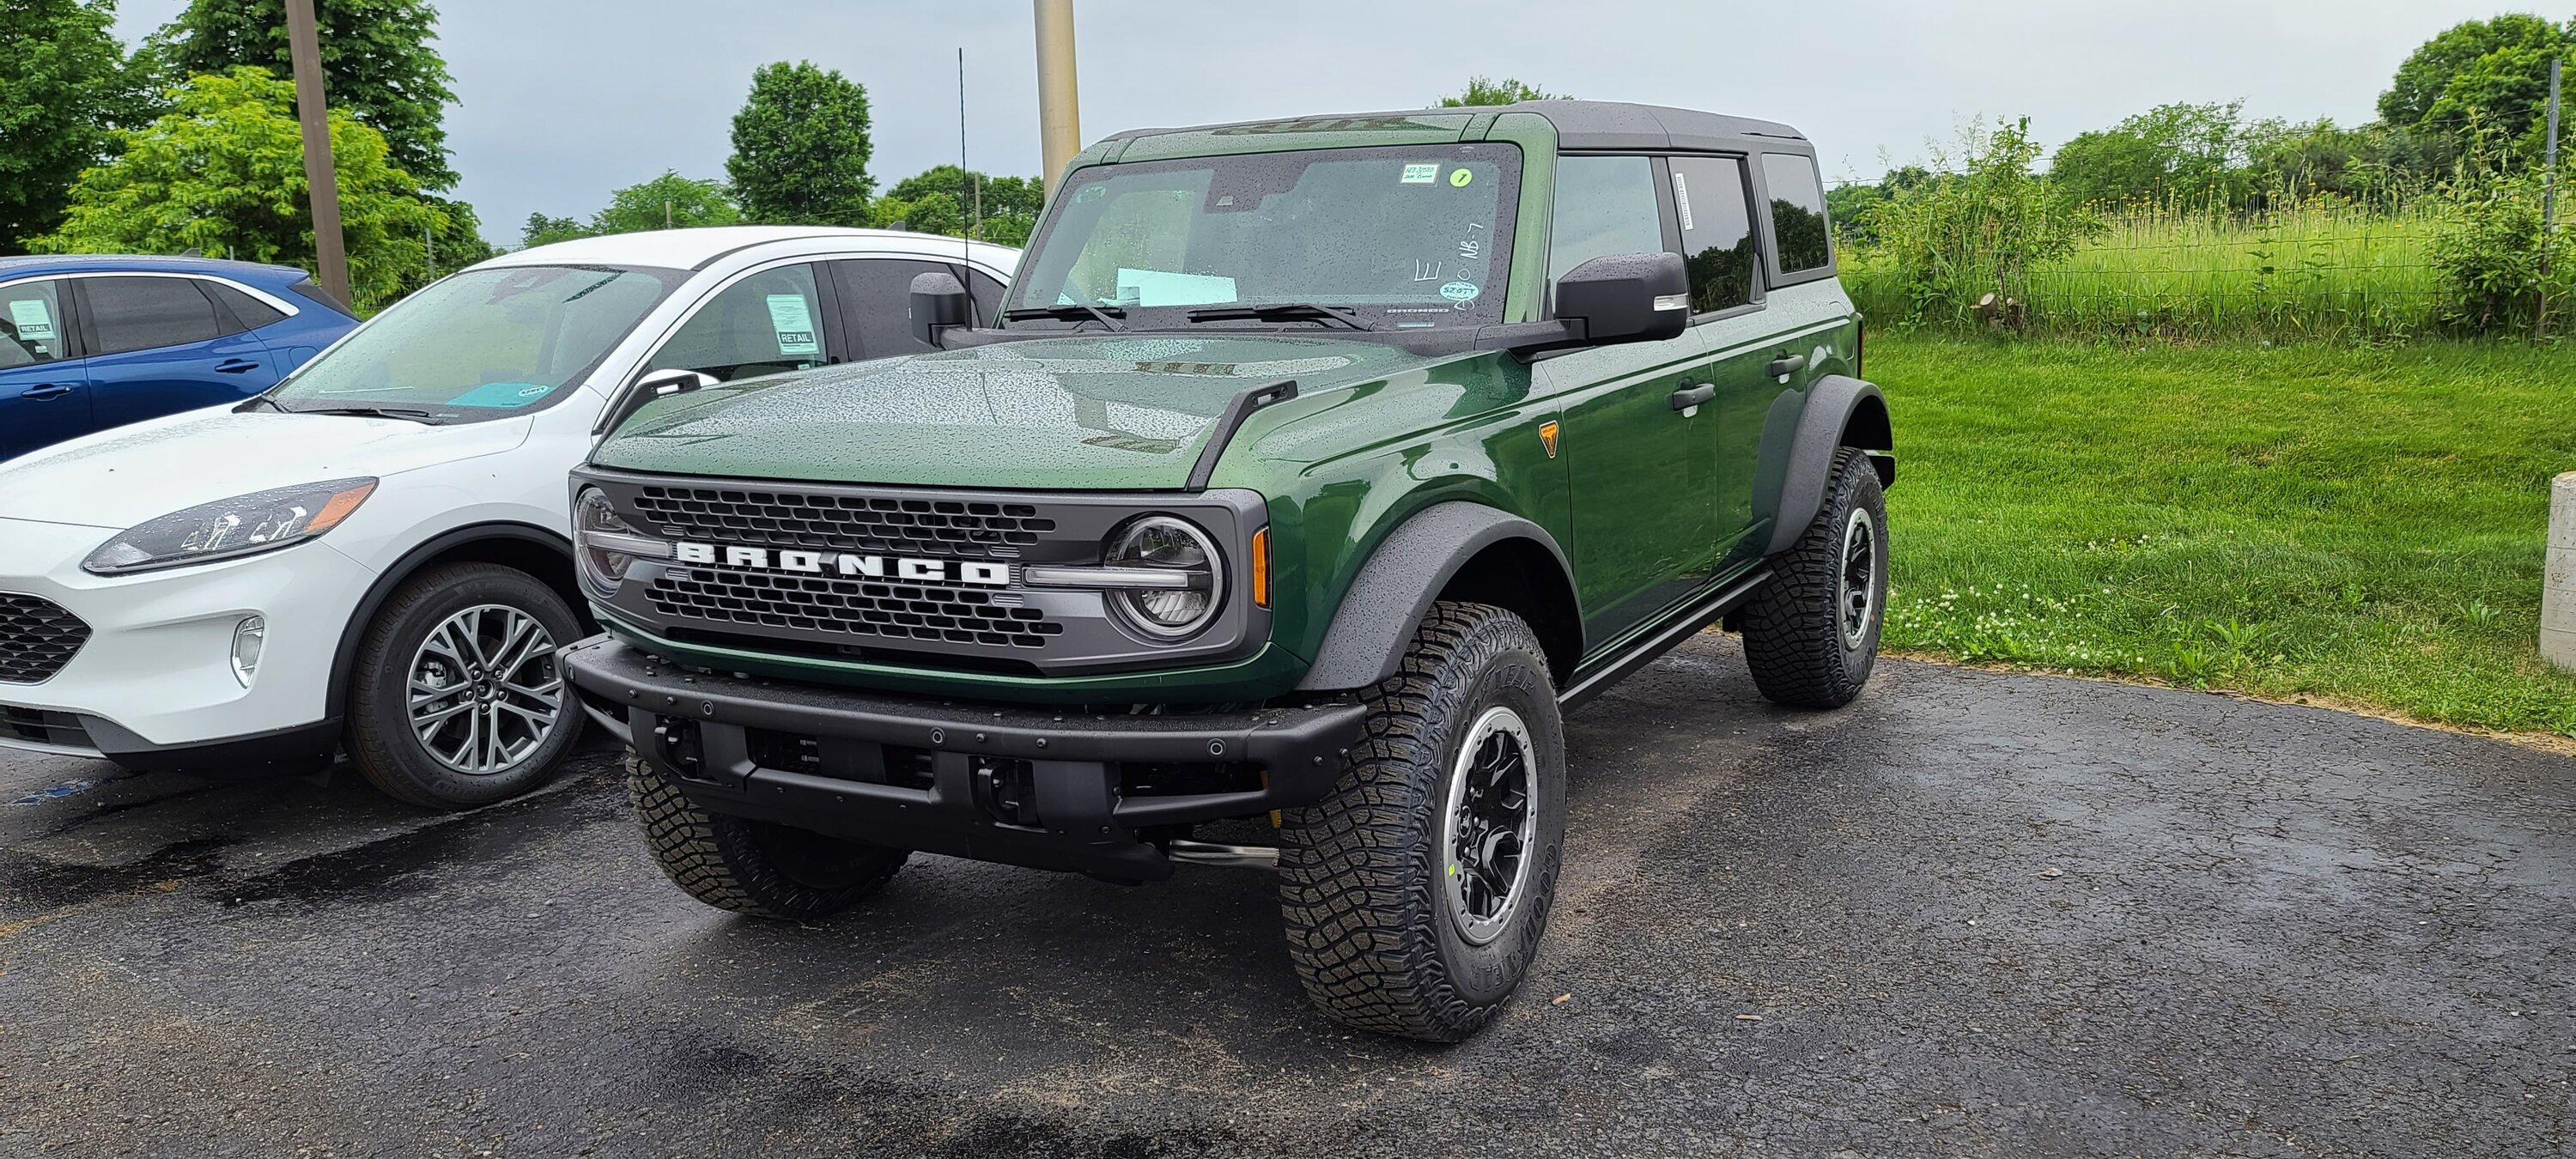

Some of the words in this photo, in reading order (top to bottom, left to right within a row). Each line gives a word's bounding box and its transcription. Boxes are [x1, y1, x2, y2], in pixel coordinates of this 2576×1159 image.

[1459, 223, 1484, 259] NB-7
[1413, 258, 1442, 282] E
[21, 325, 49, 333] RETAIL
[781, 333, 811, 343] RETAIL
[677, 541, 1011, 586] BRONCO
